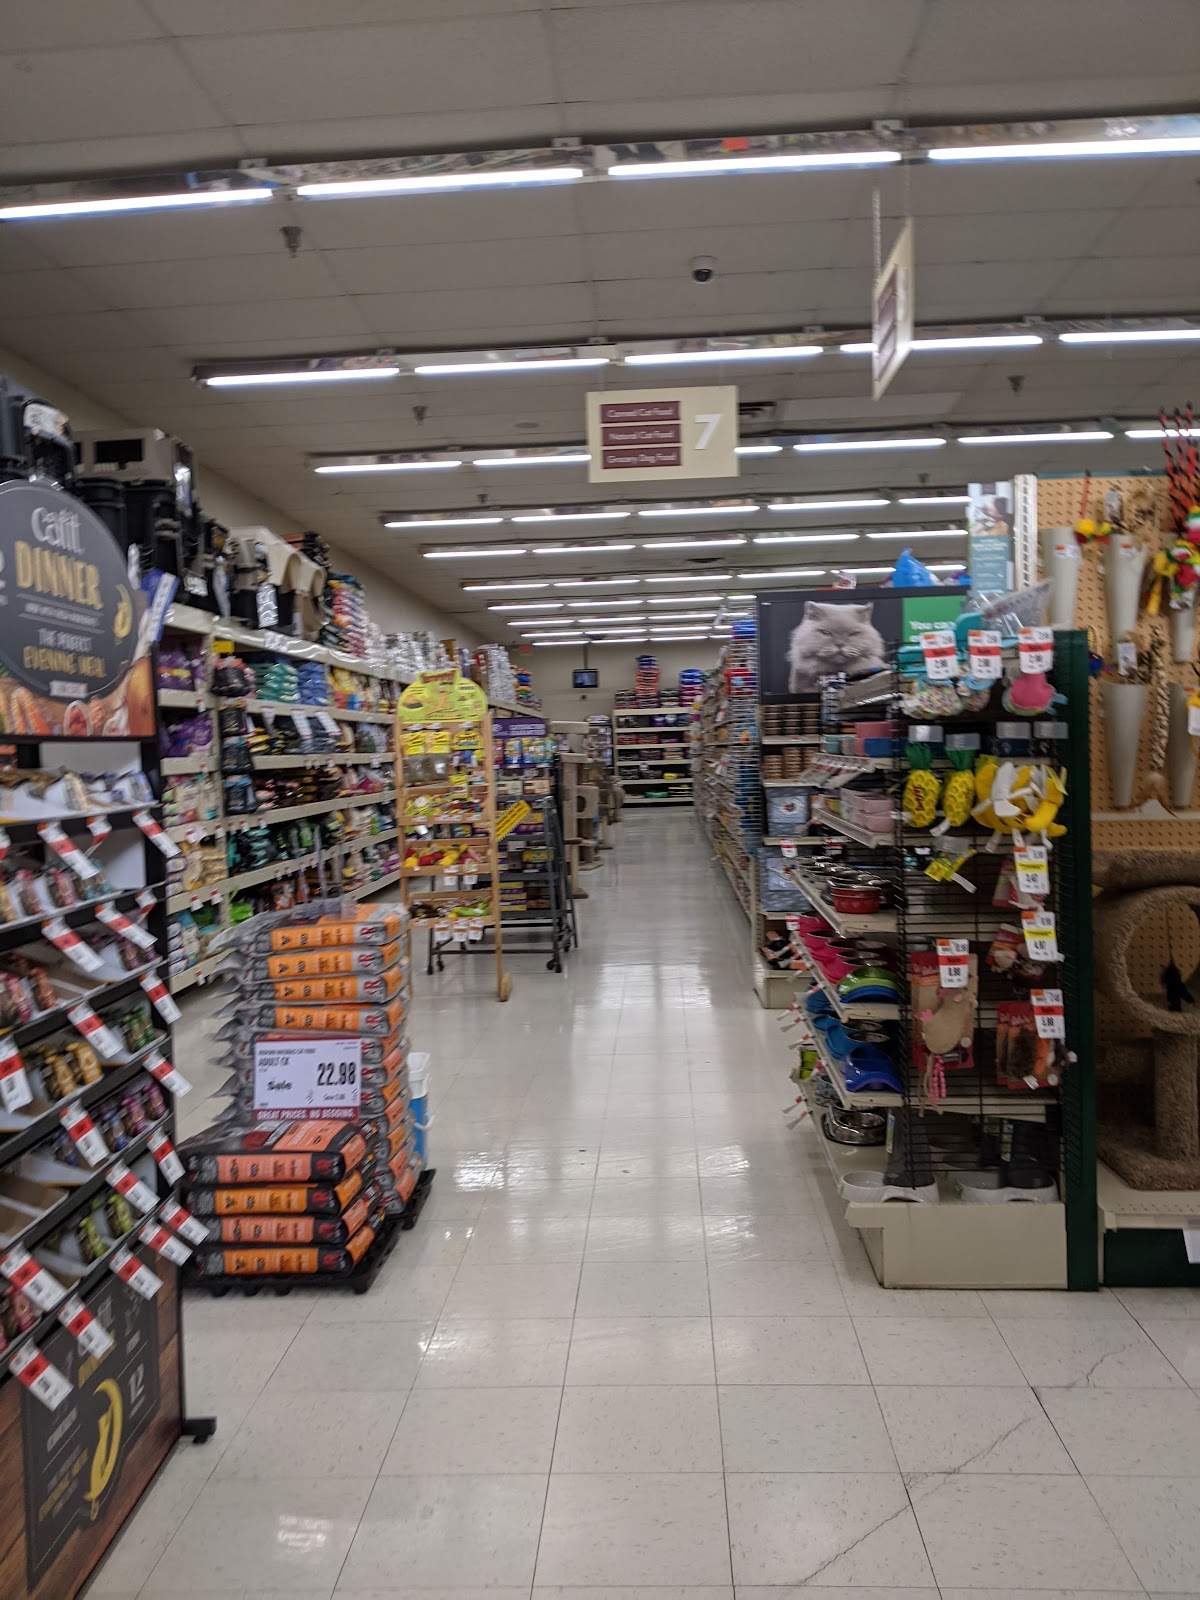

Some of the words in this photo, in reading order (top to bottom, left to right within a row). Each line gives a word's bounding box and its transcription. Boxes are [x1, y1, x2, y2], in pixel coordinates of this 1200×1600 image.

[694, 413, 722, 450] 7
[15, 540, 104, 609] DINNER
[23, 645, 77, 675] EVENING
[267, 1080, 293, 1091] Sale
[317, 1062, 357, 1087] 22.98
